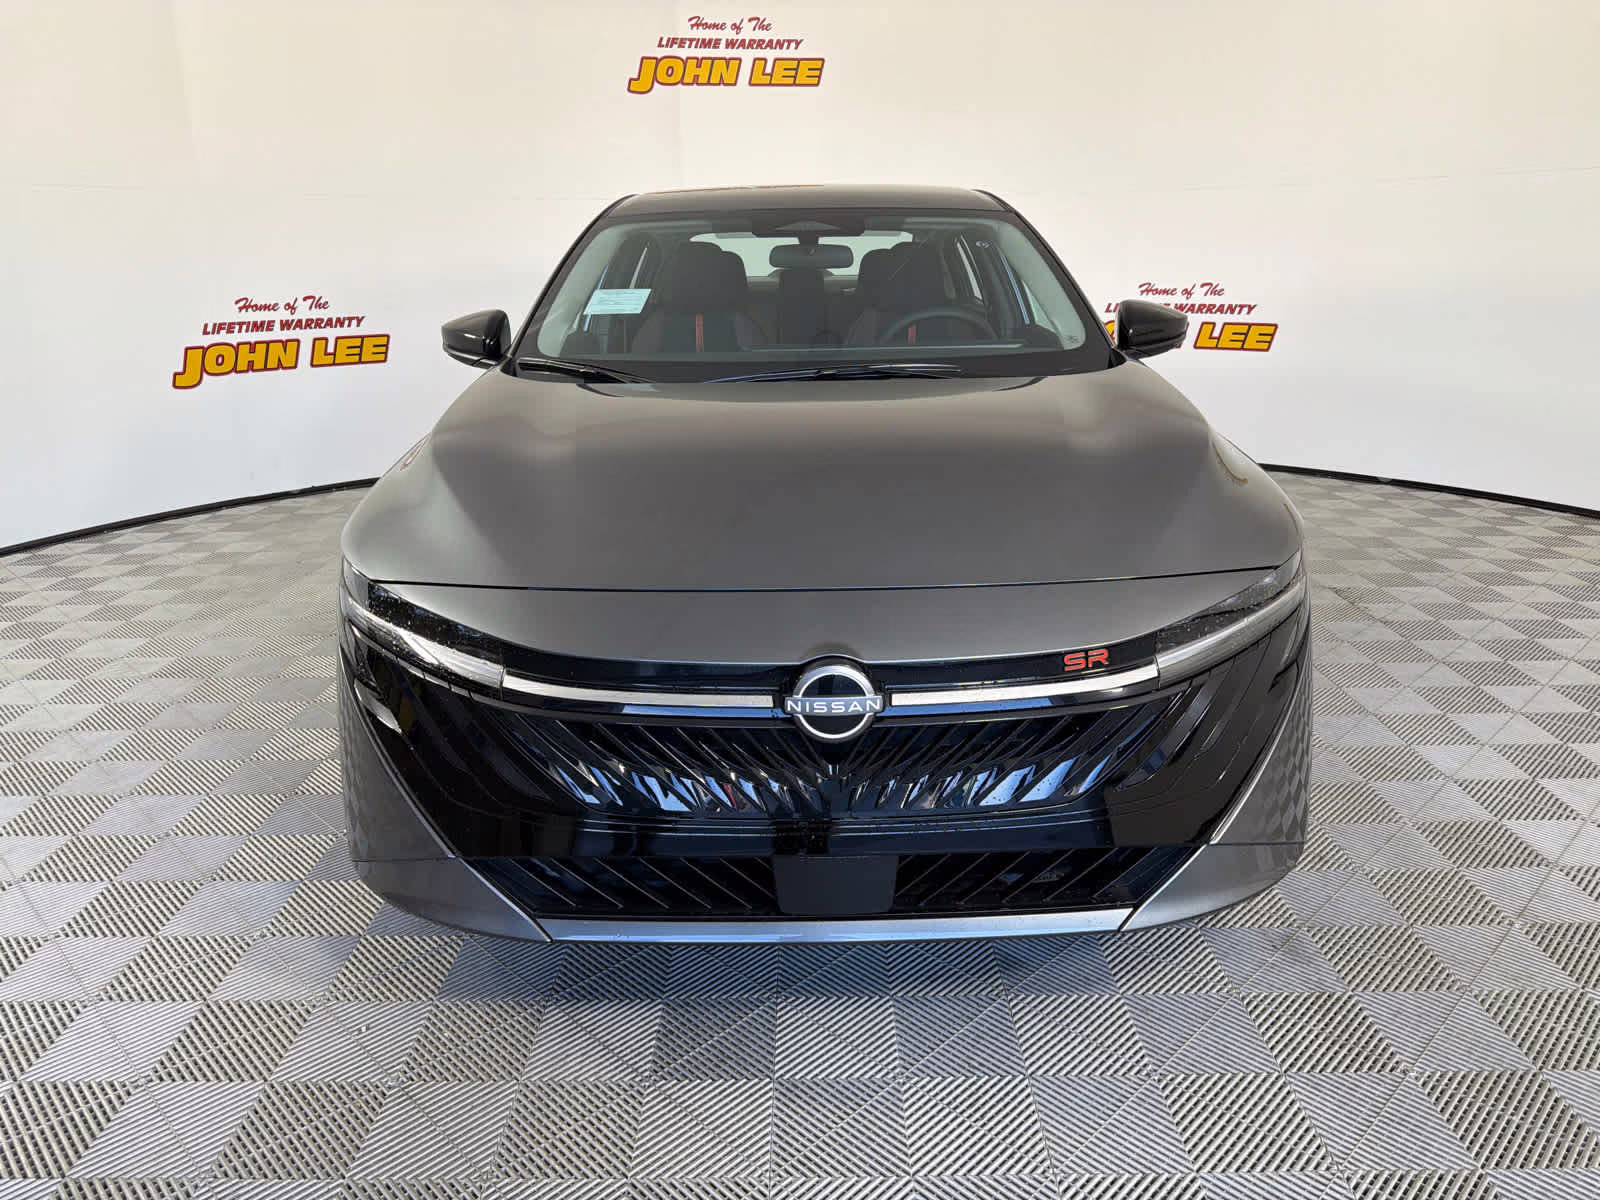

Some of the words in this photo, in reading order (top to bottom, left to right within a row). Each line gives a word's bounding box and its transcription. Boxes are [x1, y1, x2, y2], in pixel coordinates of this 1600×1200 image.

[688, 16, 727, 31] Home
[730, 18, 743, 34] of
[748, 17, 772, 31] The
[657, 37, 722, 49] LIFETIME
[725, 38, 804, 50] WARRANTY
[627, 56, 742, 94] JOHN
[749, 57, 825, 87] LEE
[1138, 282, 1178, 297] Home
[1181, 284, 1195, 300] of
[1200, 282, 1225, 297] The
[234, 297, 280, 313] Home
[284, 297, 298, 315] of
[302, 295, 330, 311] The
[1174, 303, 1258, 315] WARRANTY
[202, 319, 276, 336] LIFETIME
[279, 315, 366, 331] WARRANTY
[1193, 321, 1279, 352] LEE
[172, 338, 301, 390] JOHN
[310, 334, 391, 367] LEE
[1063, 649, 1110, 672] SR
[786, 699, 881, 713] NISSAN
